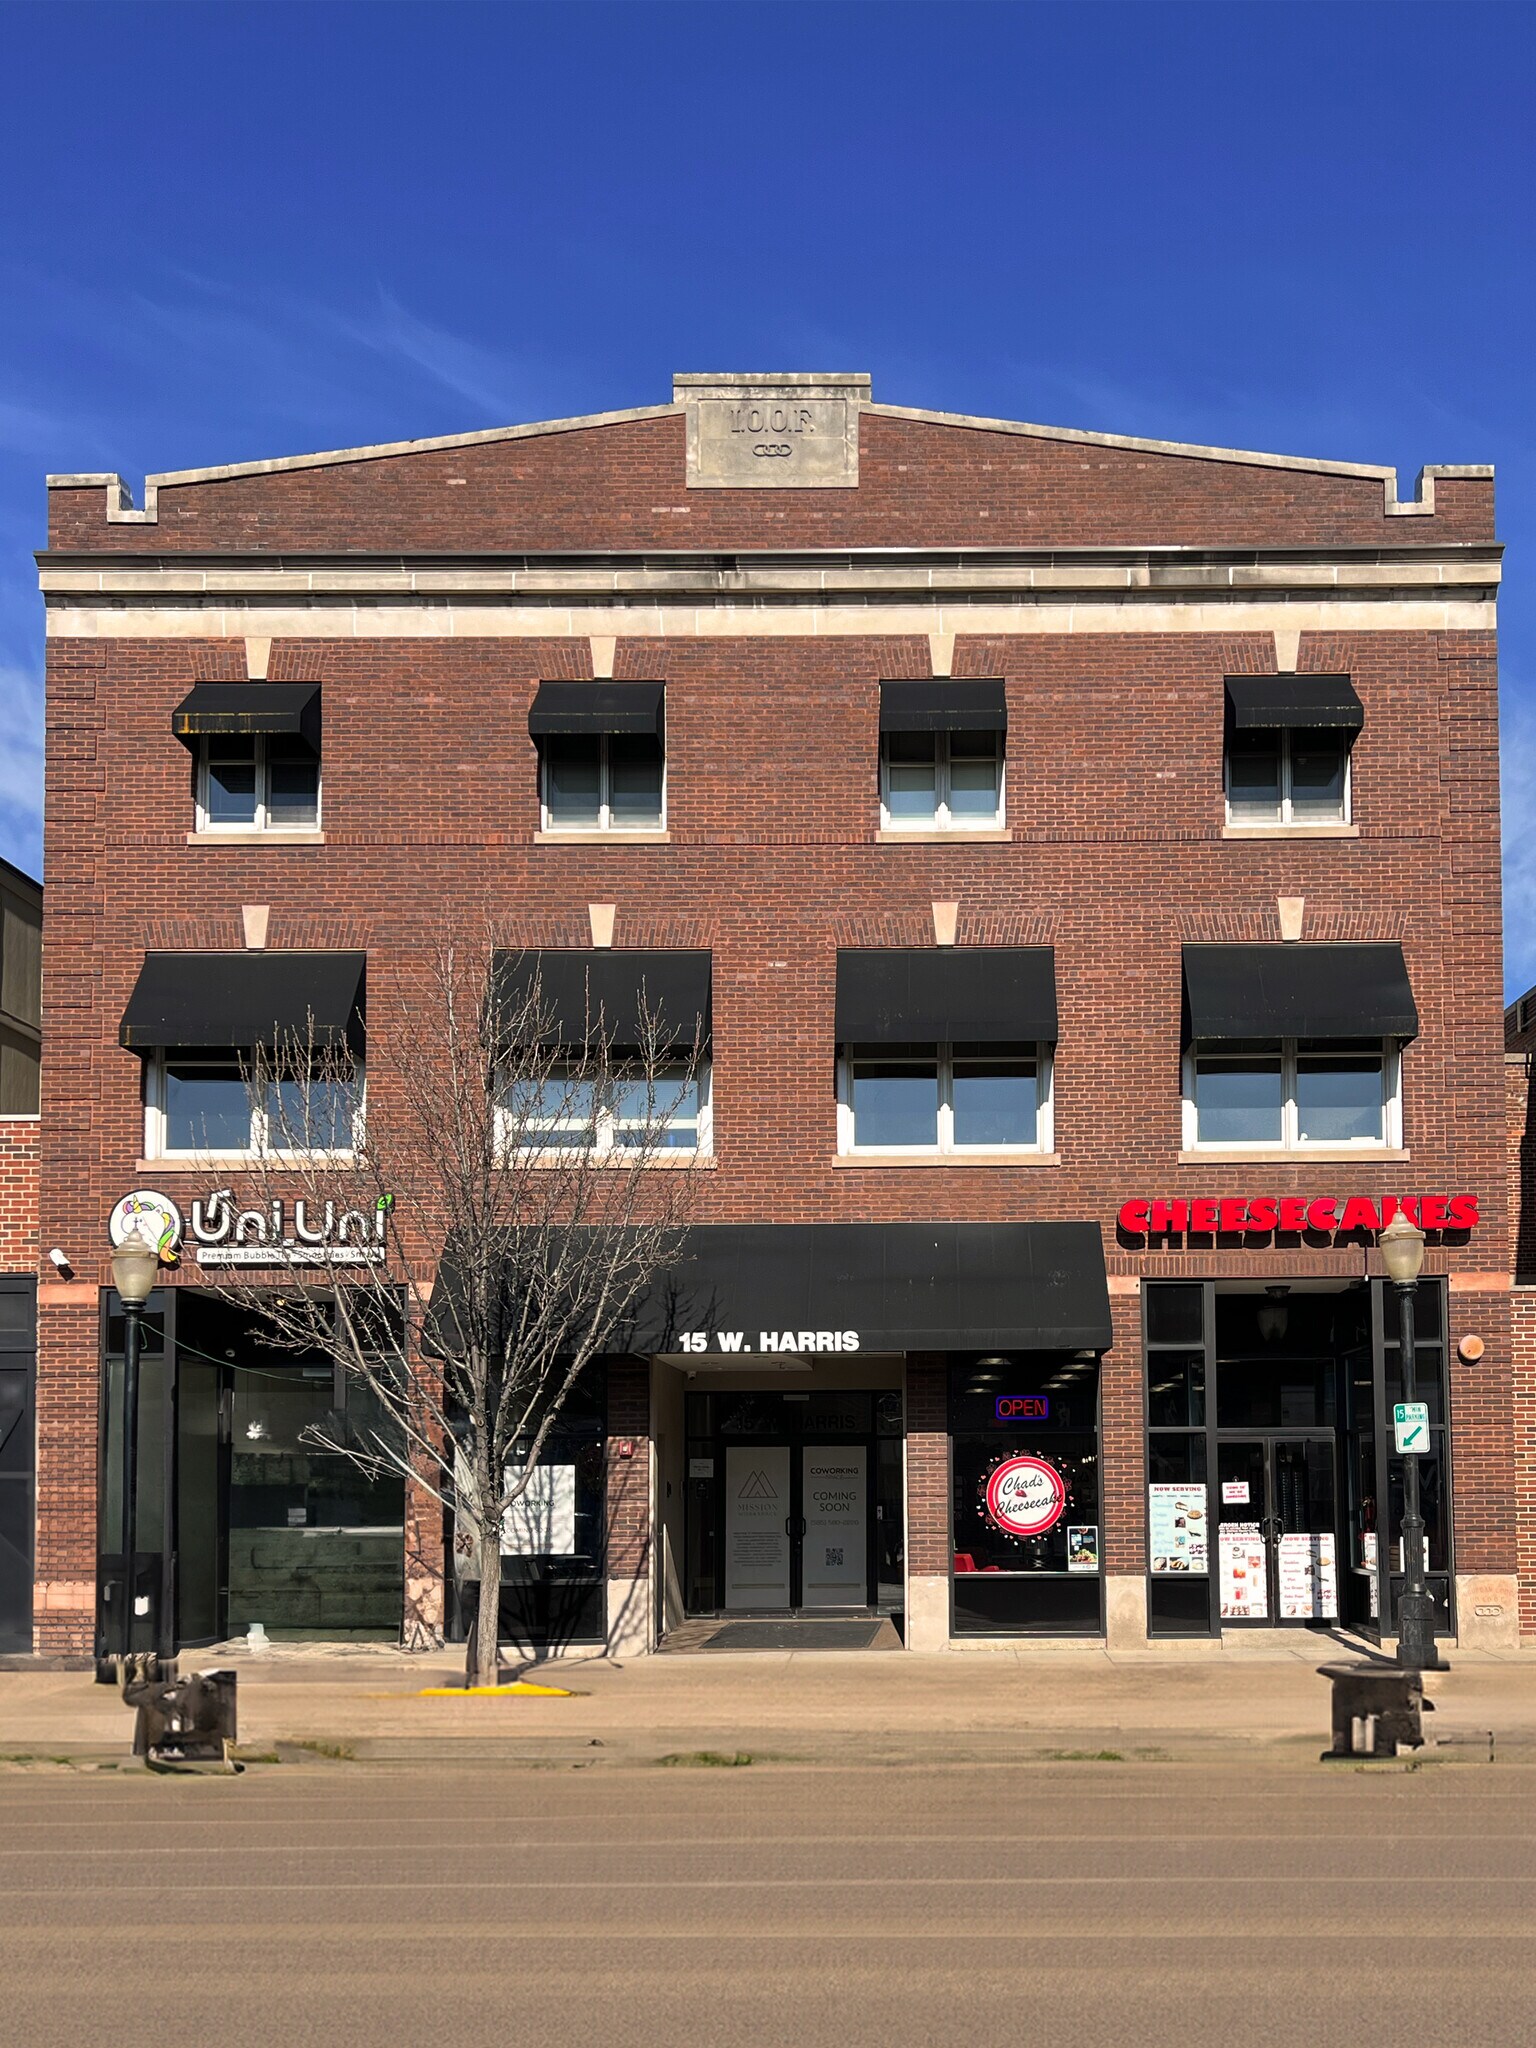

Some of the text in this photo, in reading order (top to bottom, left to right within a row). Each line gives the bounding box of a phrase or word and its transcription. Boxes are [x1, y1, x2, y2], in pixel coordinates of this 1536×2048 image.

[1117, 1195, 1480, 1232] CHEESECAKES
[679, 1331, 860, 1352] 15 W. HARRIS
[998, 1399, 1046, 1416] OPEN
[1397, 1409, 1405, 1419] 15
[810, 1467, 859, 1475] COWORKING
[1003, 1474, 1044, 1495] Chad's
[813, 1491, 857, 1501] COMING
[994, 1490, 1063, 1519] Cheesecake
[819, 1502, 850, 1512] SOON
